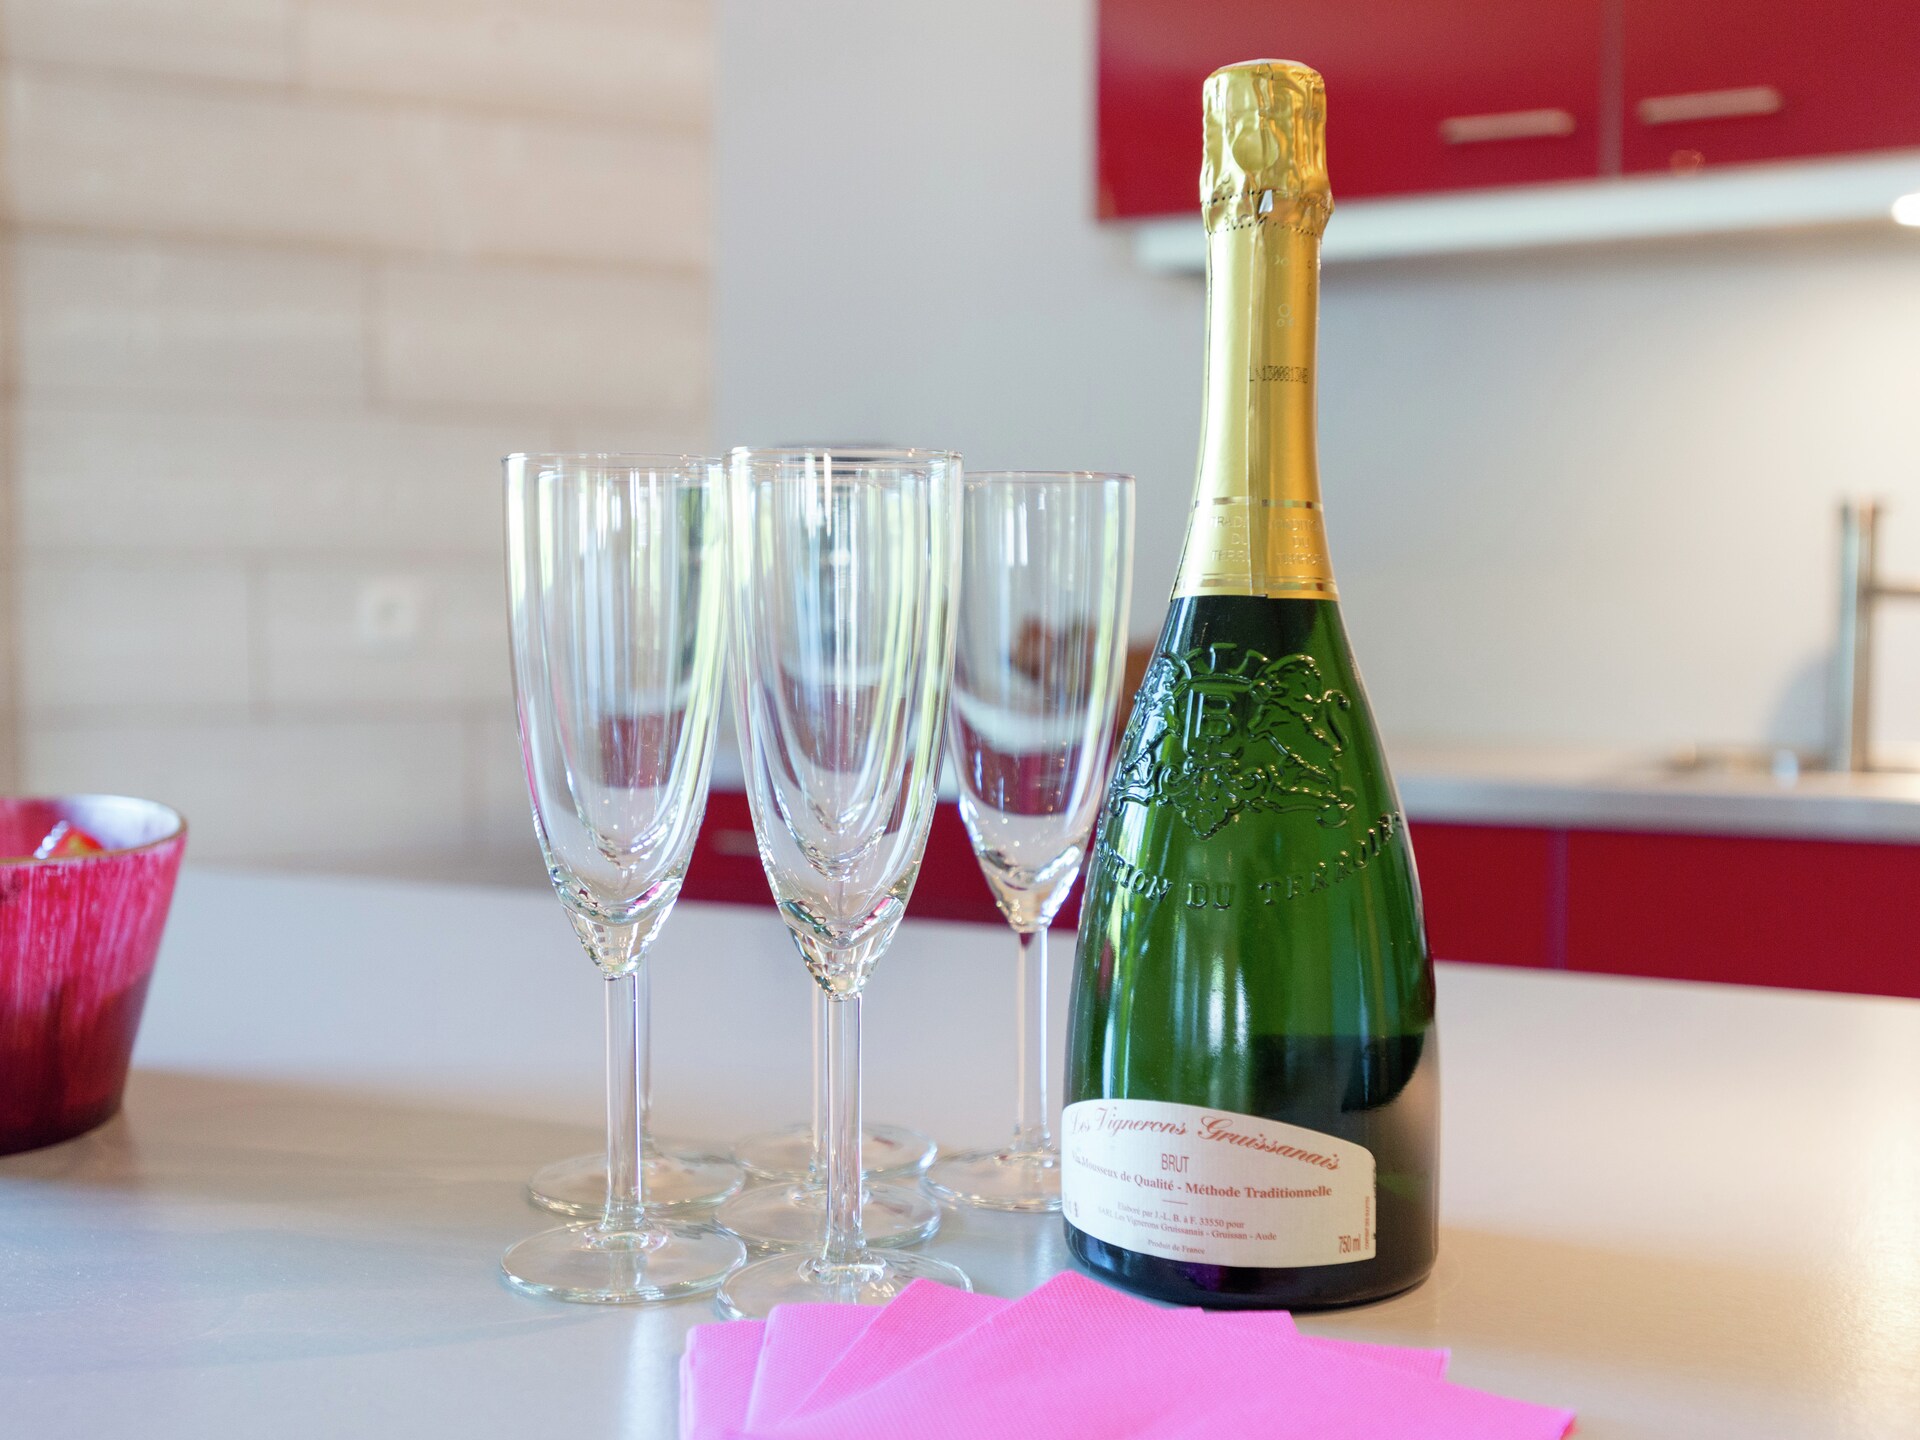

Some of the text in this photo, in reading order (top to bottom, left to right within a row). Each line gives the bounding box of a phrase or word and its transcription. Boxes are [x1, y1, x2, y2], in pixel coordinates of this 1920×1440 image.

[1186, 882, 1233, 910] DU
[1095, 1105, 1187, 1137] Vignerons
[1196, 1115, 1341, 1171] Gruissanais
[1161, 1152, 1190, 1174] BRUT
[1081, 1155, 1118, 1179] Mousseux
[1120, 1170, 1132, 1183] de
[1133, 1173, 1174, 1192] Qualité
[1185, 1182, 1241, 1199] Méthode
[1244, 1185, 1333, 1199] Traditionnelle
[1160, 1221, 1204, 1237] Gruissanais
[1212, 1229, 1248, 1240] Gruissan
[1255, 1232, 1277, 1241] Aude
[1199, 1217, 1224, 1228] 33550
[1226, 1220, 1245, 1230] pour
[1338, 1234, 1352, 1254] 750
